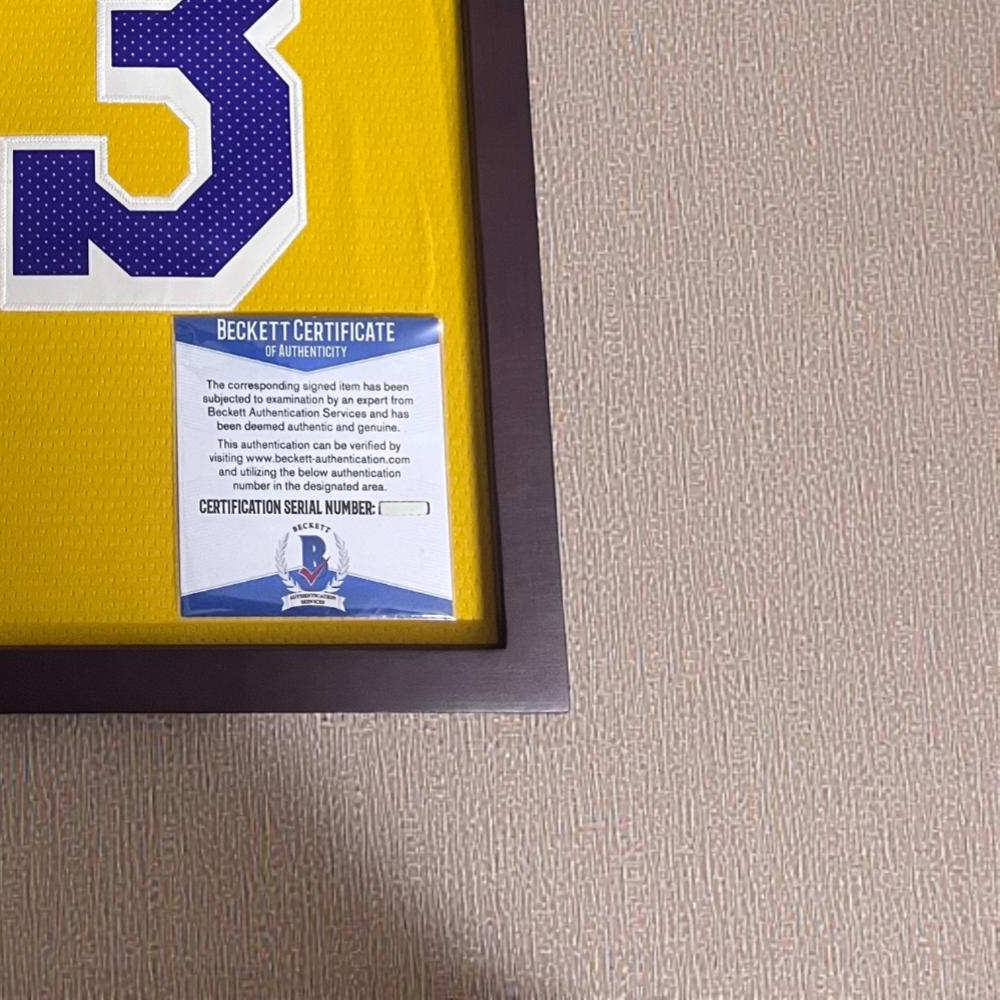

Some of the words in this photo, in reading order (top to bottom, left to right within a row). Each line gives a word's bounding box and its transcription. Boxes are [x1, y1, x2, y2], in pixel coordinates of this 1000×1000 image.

[216, 318, 290, 341] BECKETT
[293, 318, 396, 342] CERTIFICATE
[265, 345, 277, 357] OF
[279, 344, 347, 358] AUTHENTICITY
[206, 379, 225, 389] The
[228, 381, 300, 392] corresponding
[303, 382, 336, 393] signed
[339, 382, 360, 391] item
[363, 382, 381, 391] has
[384, 382, 409, 391] been
[203, 393, 251, 405] subjected
[254, 394, 263, 403] to
[266, 394, 324, 404] examination
[327, 395, 338, 406] by
[342, 397, 354, 405] an
[357, 396, 388, 407] expert
[391, 395, 414, 405] from
[208, 407, 246, 417] Beckett
[249, 407, 319, 417] Authentication
[323, 408, 367, 418] Services
[370, 408, 388, 418] and
[391, 408, 409, 418] has
[217, 421, 241, 430] been
[244, 421, 284, 431] deemed
[287, 421, 333, 431] authentic
[336, 422, 354, 432] and
[357, 422, 401, 434] genuine.
[217, 439, 238, 449] This
[241, 440, 310, 450] authentication
[313, 442, 331, 450] can
[334, 441, 347, 450] be
[350, 441, 386, 450] verified
[389, 441, 401, 453] by
[209, 452, 243, 465] visiting
[246, 453, 411, 464] www.beckett-authentication.com
[218, 467, 237, 476] and
[240, 467, 277, 479] utilizing
[279, 467, 295, 477] the
[298, 468, 328, 477] below
[331, 468, 401, 478] authentication
[232, 481, 270, 490] number
[273, 480, 282, 490] in
[285, 481, 300, 490] the
[303, 481, 359, 493] designated
[362, 483, 388, 491] area.
[199, 499, 281, 514] CERTIFICATION
[284, 499, 322, 515] SERIAL
[325, 499, 376, 515] NUMBER:
[292, 522, 332, 533] BECKETT
